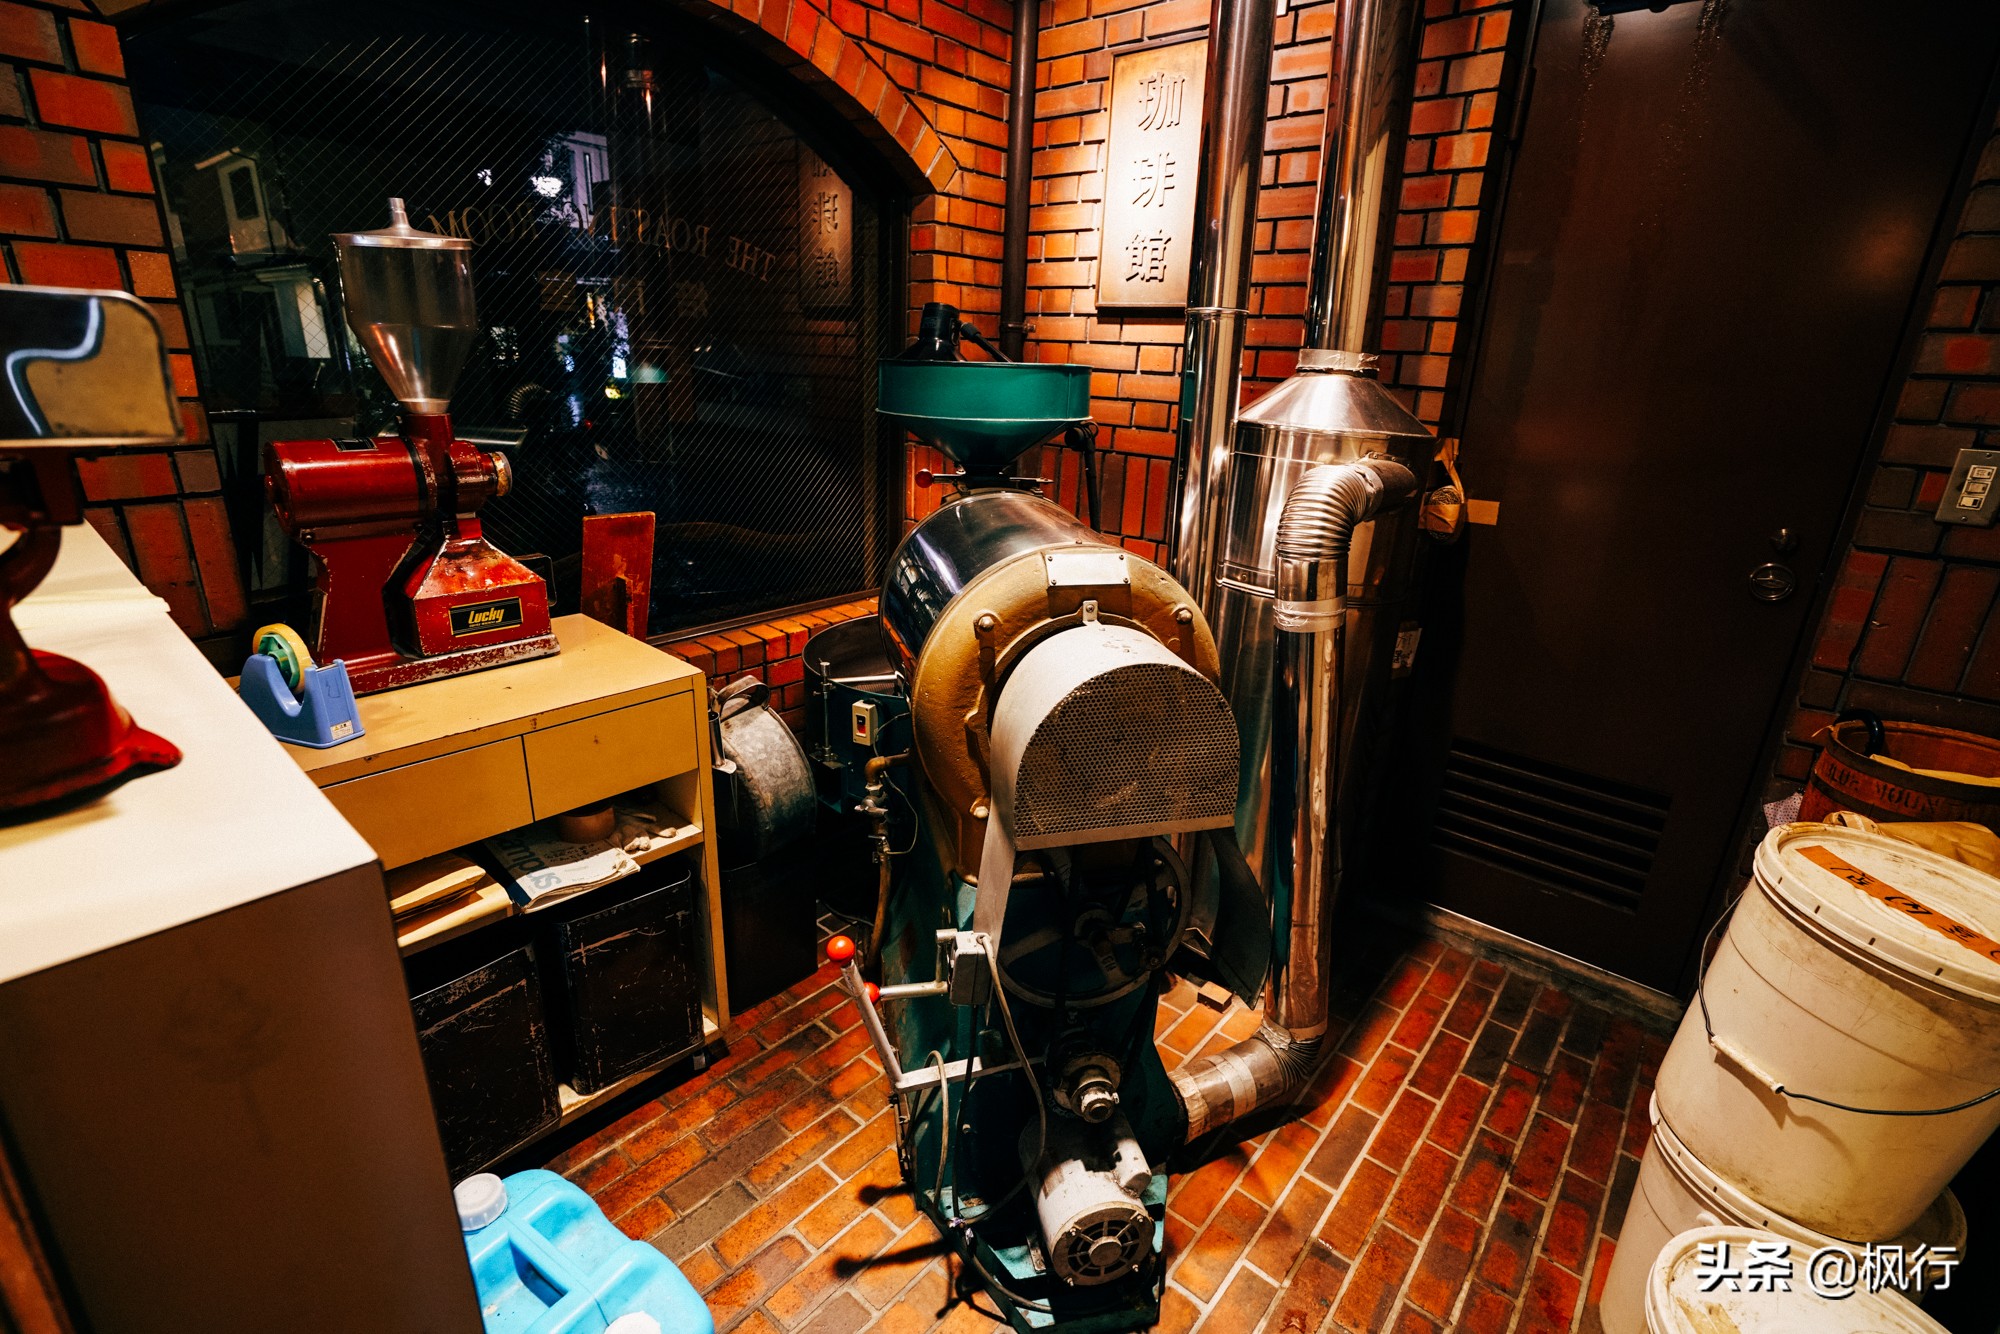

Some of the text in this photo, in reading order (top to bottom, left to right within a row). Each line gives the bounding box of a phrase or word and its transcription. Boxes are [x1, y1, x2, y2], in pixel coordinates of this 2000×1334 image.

[1125, 72, 1186, 283] 珈琲館
[468, 607, 505, 625] Lucky
